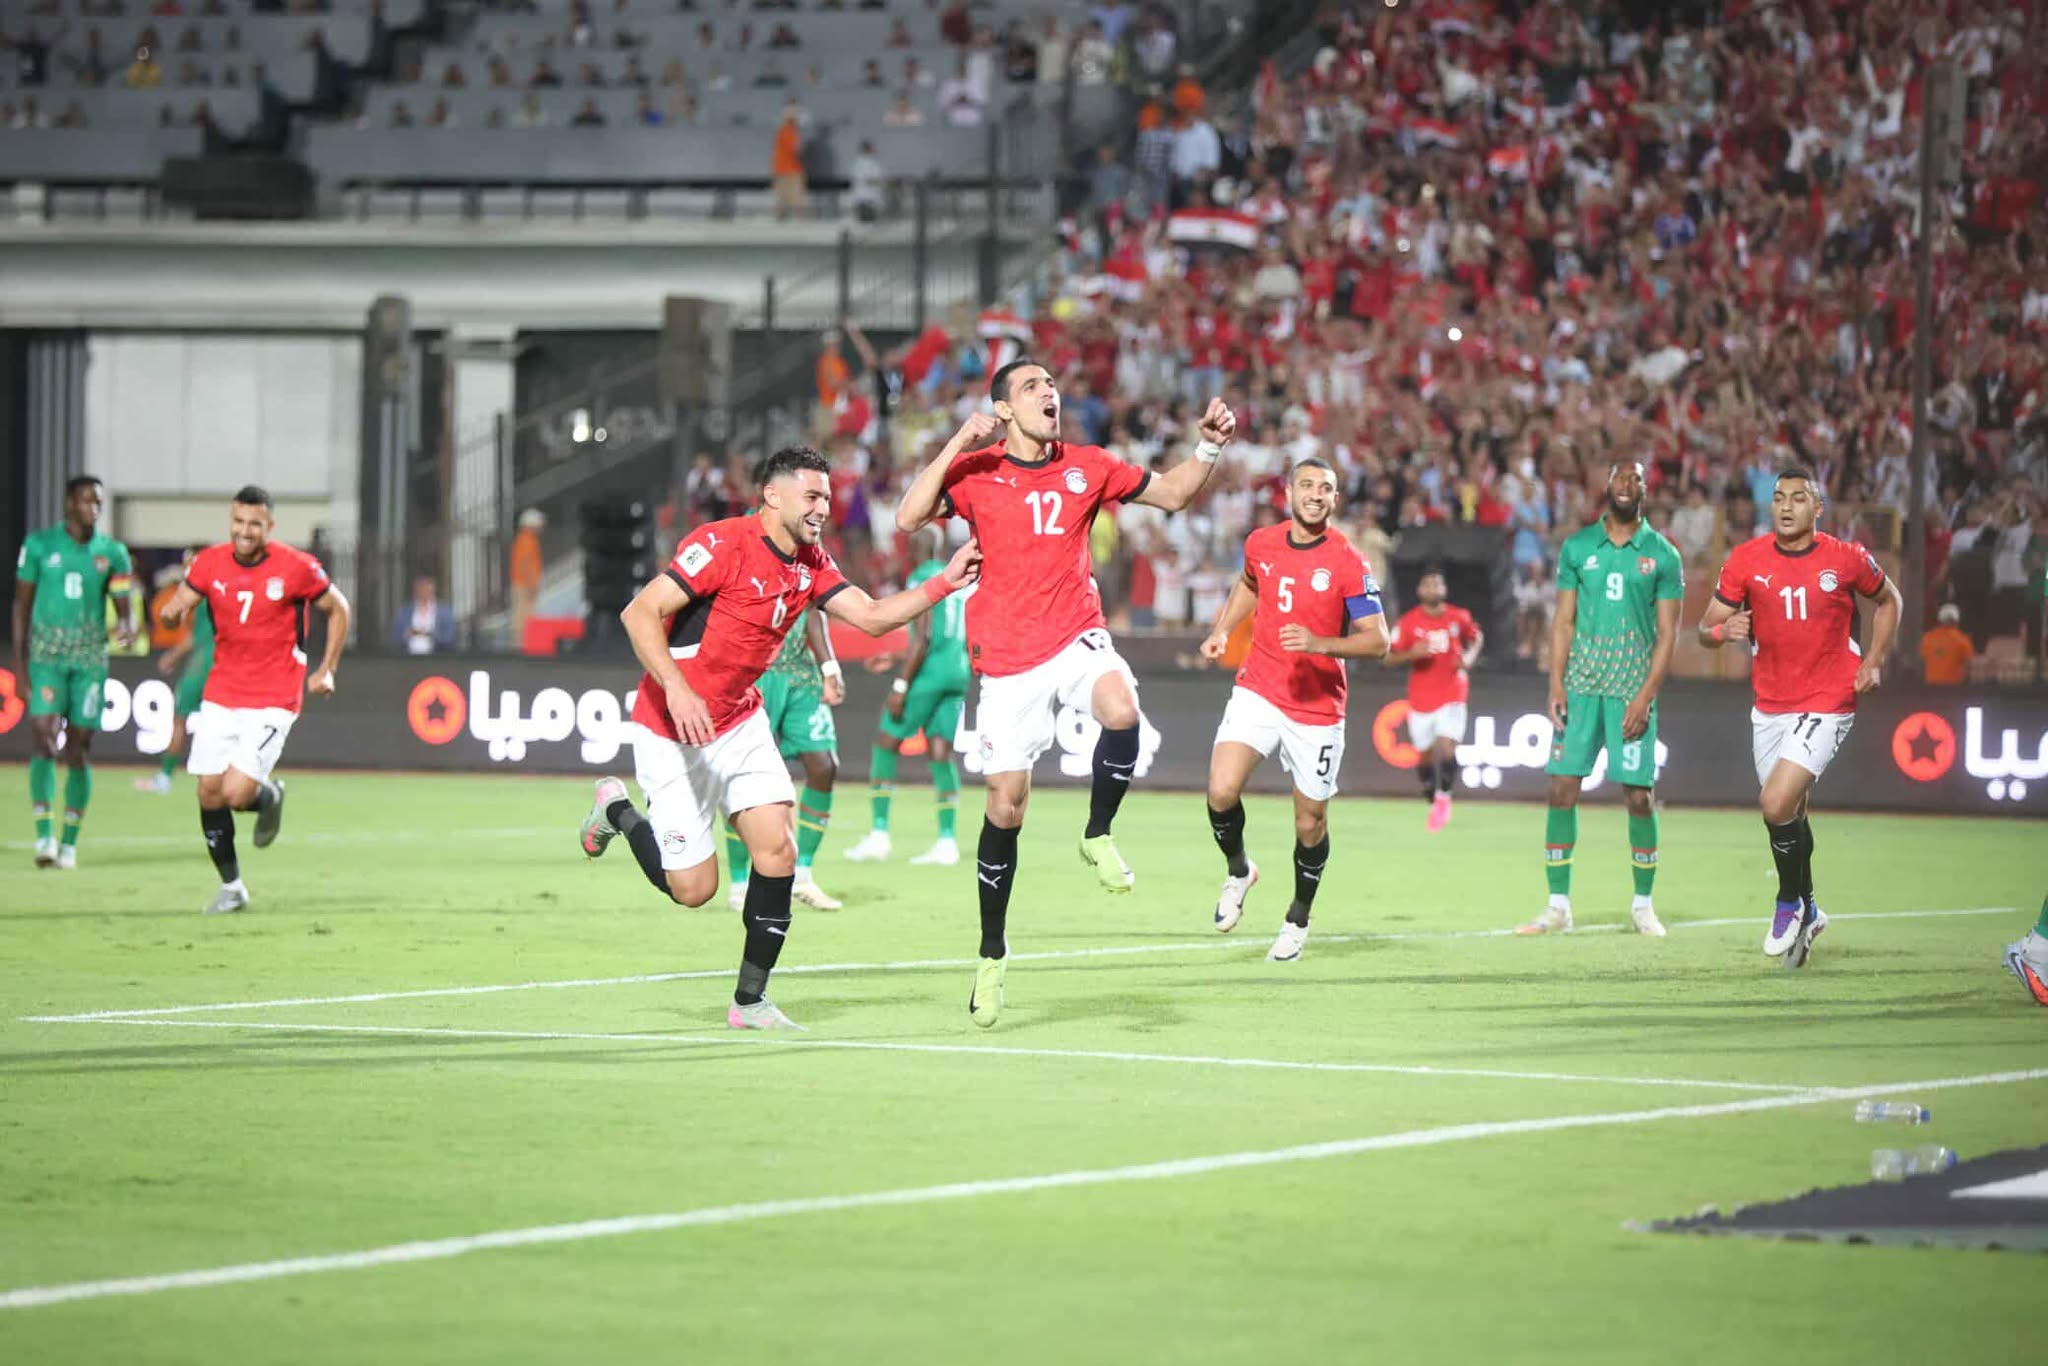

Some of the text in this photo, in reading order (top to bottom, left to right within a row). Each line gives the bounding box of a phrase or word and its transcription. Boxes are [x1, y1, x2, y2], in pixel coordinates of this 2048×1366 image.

[1025, 491, 1066, 536] 12
[64, 572, 83, 600] 6
[1277, 576, 1296, 613] 5
[1606, 572, 1624, 601] 9
[236, 590, 254, 624] 7
[771, 594, 788, 629] 6
[1779, 586, 1808, 621] 11
[469, 670, 639, 764] وميا
[258, 724, 278, 751] 7
[1316, 744, 1333, 777] 5
[1622, 742, 1642, 771] 9
